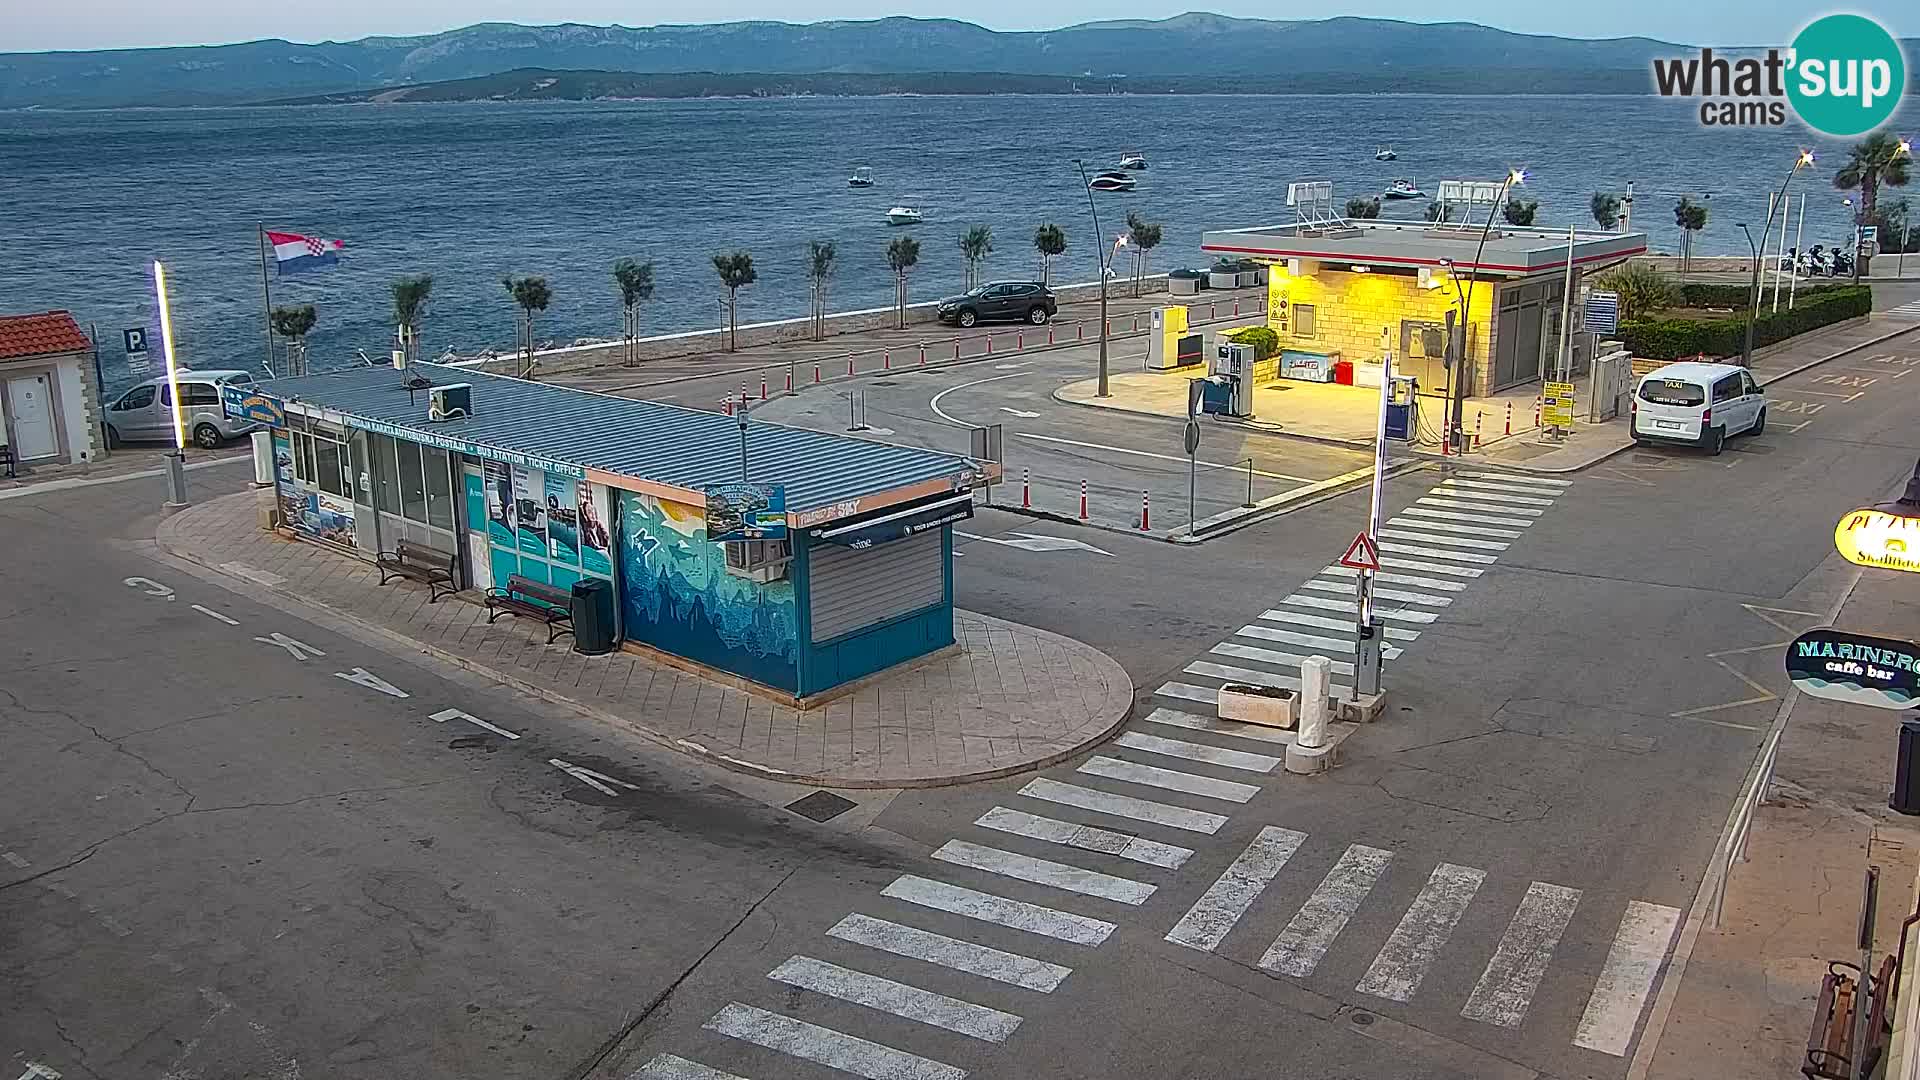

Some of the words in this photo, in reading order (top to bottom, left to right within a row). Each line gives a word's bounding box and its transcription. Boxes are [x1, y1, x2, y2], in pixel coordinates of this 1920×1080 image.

[129, 331, 142, 350] P
[1664, 380, 1683, 389] TAXI
[1810, 374, 1879, 388] TAXI
[394, 427, 435, 445] AUTOBUSNA
[435, 436, 467, 453] POSTAJA
[476, 446, 492, 457] BUS
[492, 449, 525, 465] STATION
[526, 456, 554, 471] TICKET
[554, 463, 581, 477] OFFICE
[913, 522, 927, 532] YOUR
[1797, 641, 1920, 675] MARINERO
[1825, 660, 1864, 676] caffe
[1866, 664, 1895, 681] bar
